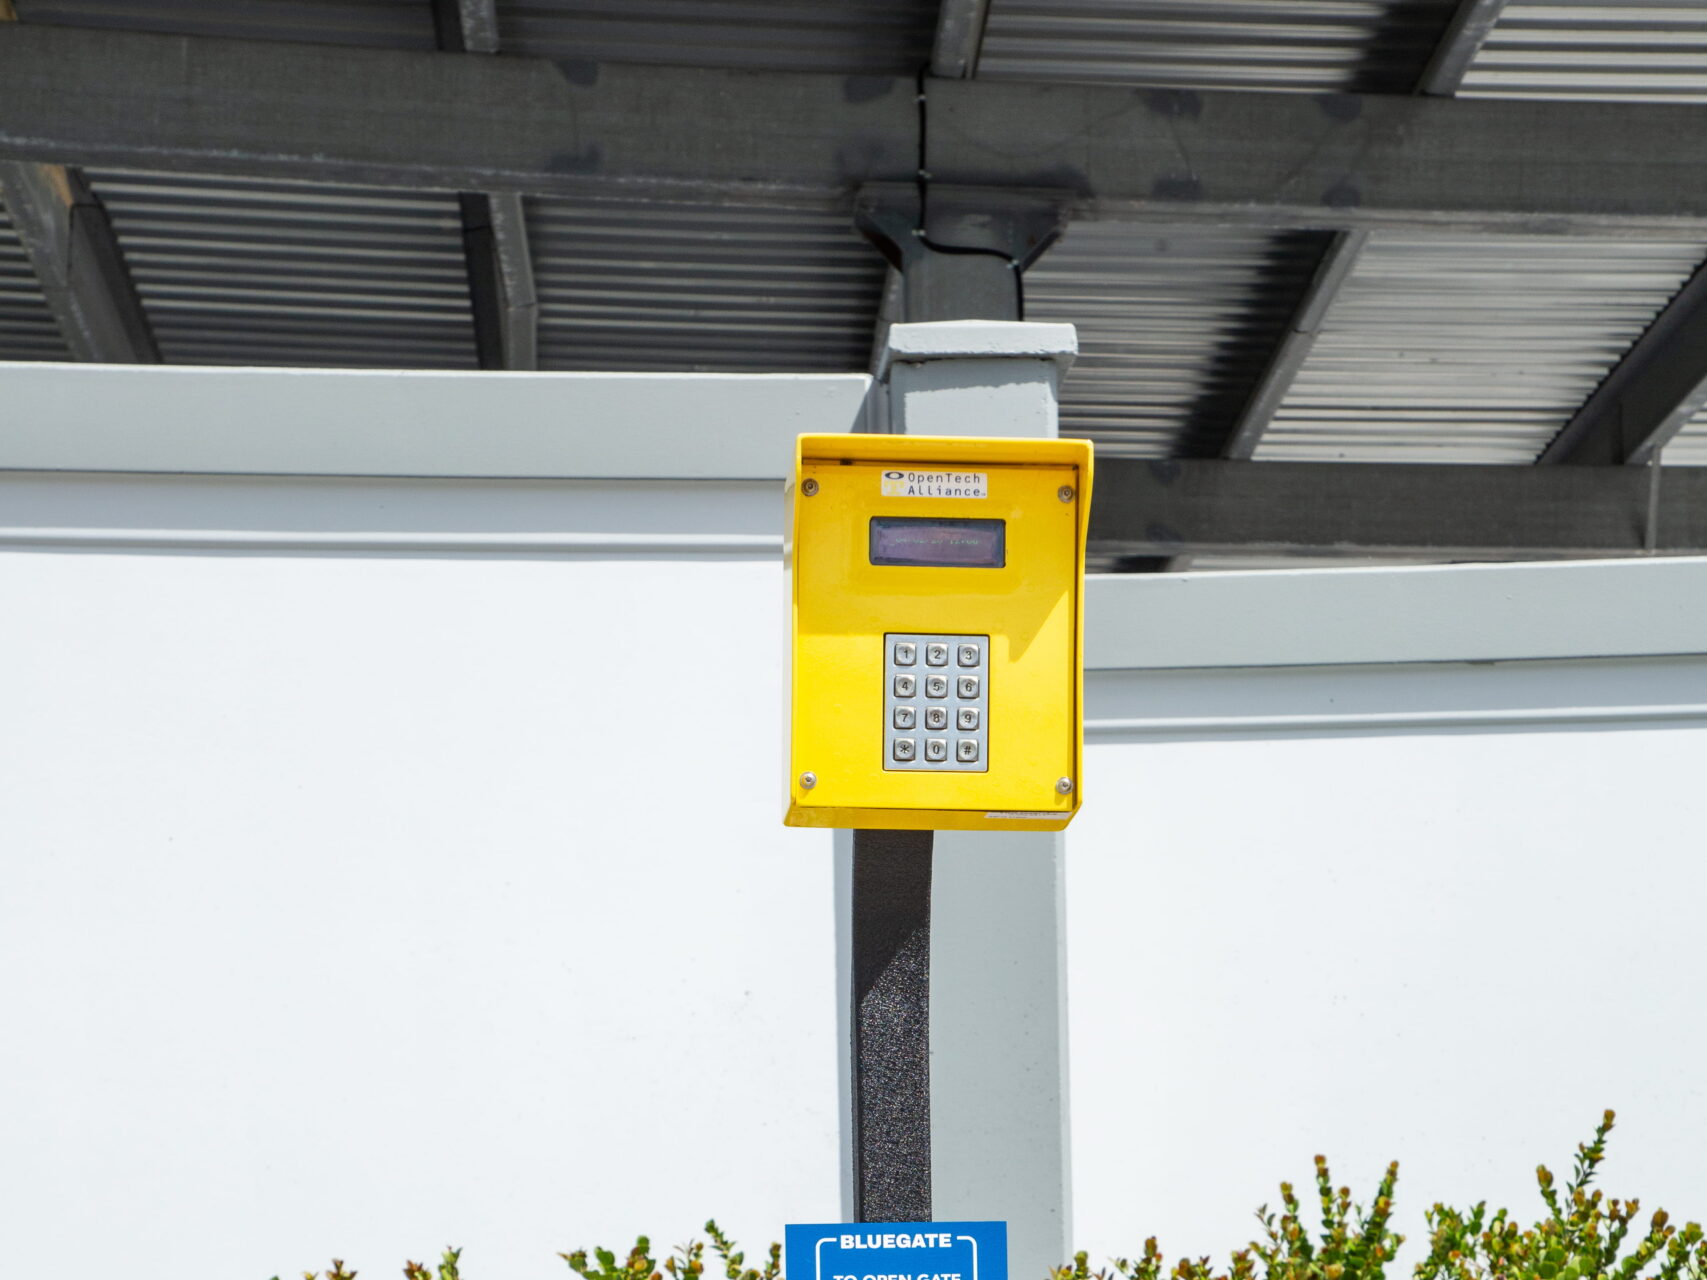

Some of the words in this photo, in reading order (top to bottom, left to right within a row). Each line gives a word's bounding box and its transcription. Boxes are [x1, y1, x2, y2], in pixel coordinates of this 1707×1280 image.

[908, 473, 980, 484] OpenTech
[908, 485, 980, 496] Alliance
[840, 1233, 952, 1250] BLUEGATE
